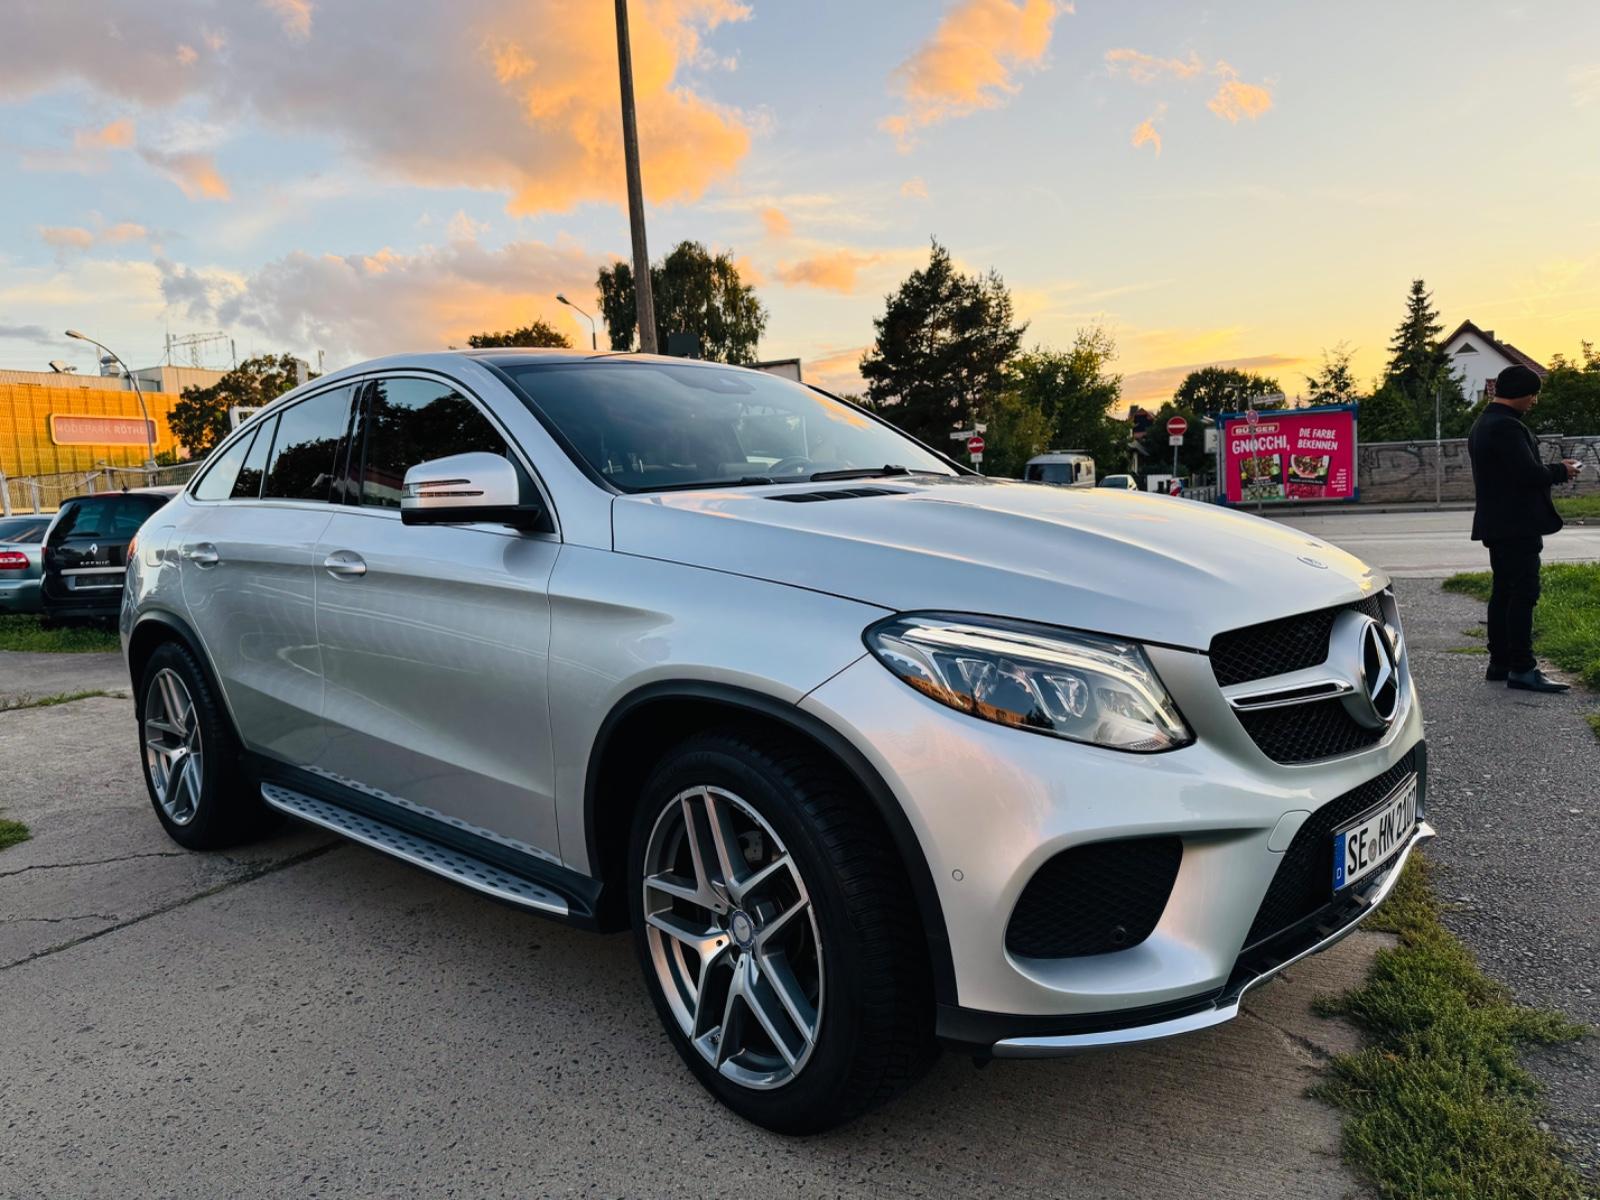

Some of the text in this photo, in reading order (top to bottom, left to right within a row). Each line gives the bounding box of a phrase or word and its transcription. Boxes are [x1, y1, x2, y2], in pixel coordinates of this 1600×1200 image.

[1299, 428, 1336, 439] DIE FARBE
[1232, 435, 1290, 454] GNOCCHI,
[1297, 438, 1338, 450] BEKENNEN
[1347, 828, 1369, 876] SE
[1378, 808, 1395, 857] HN
